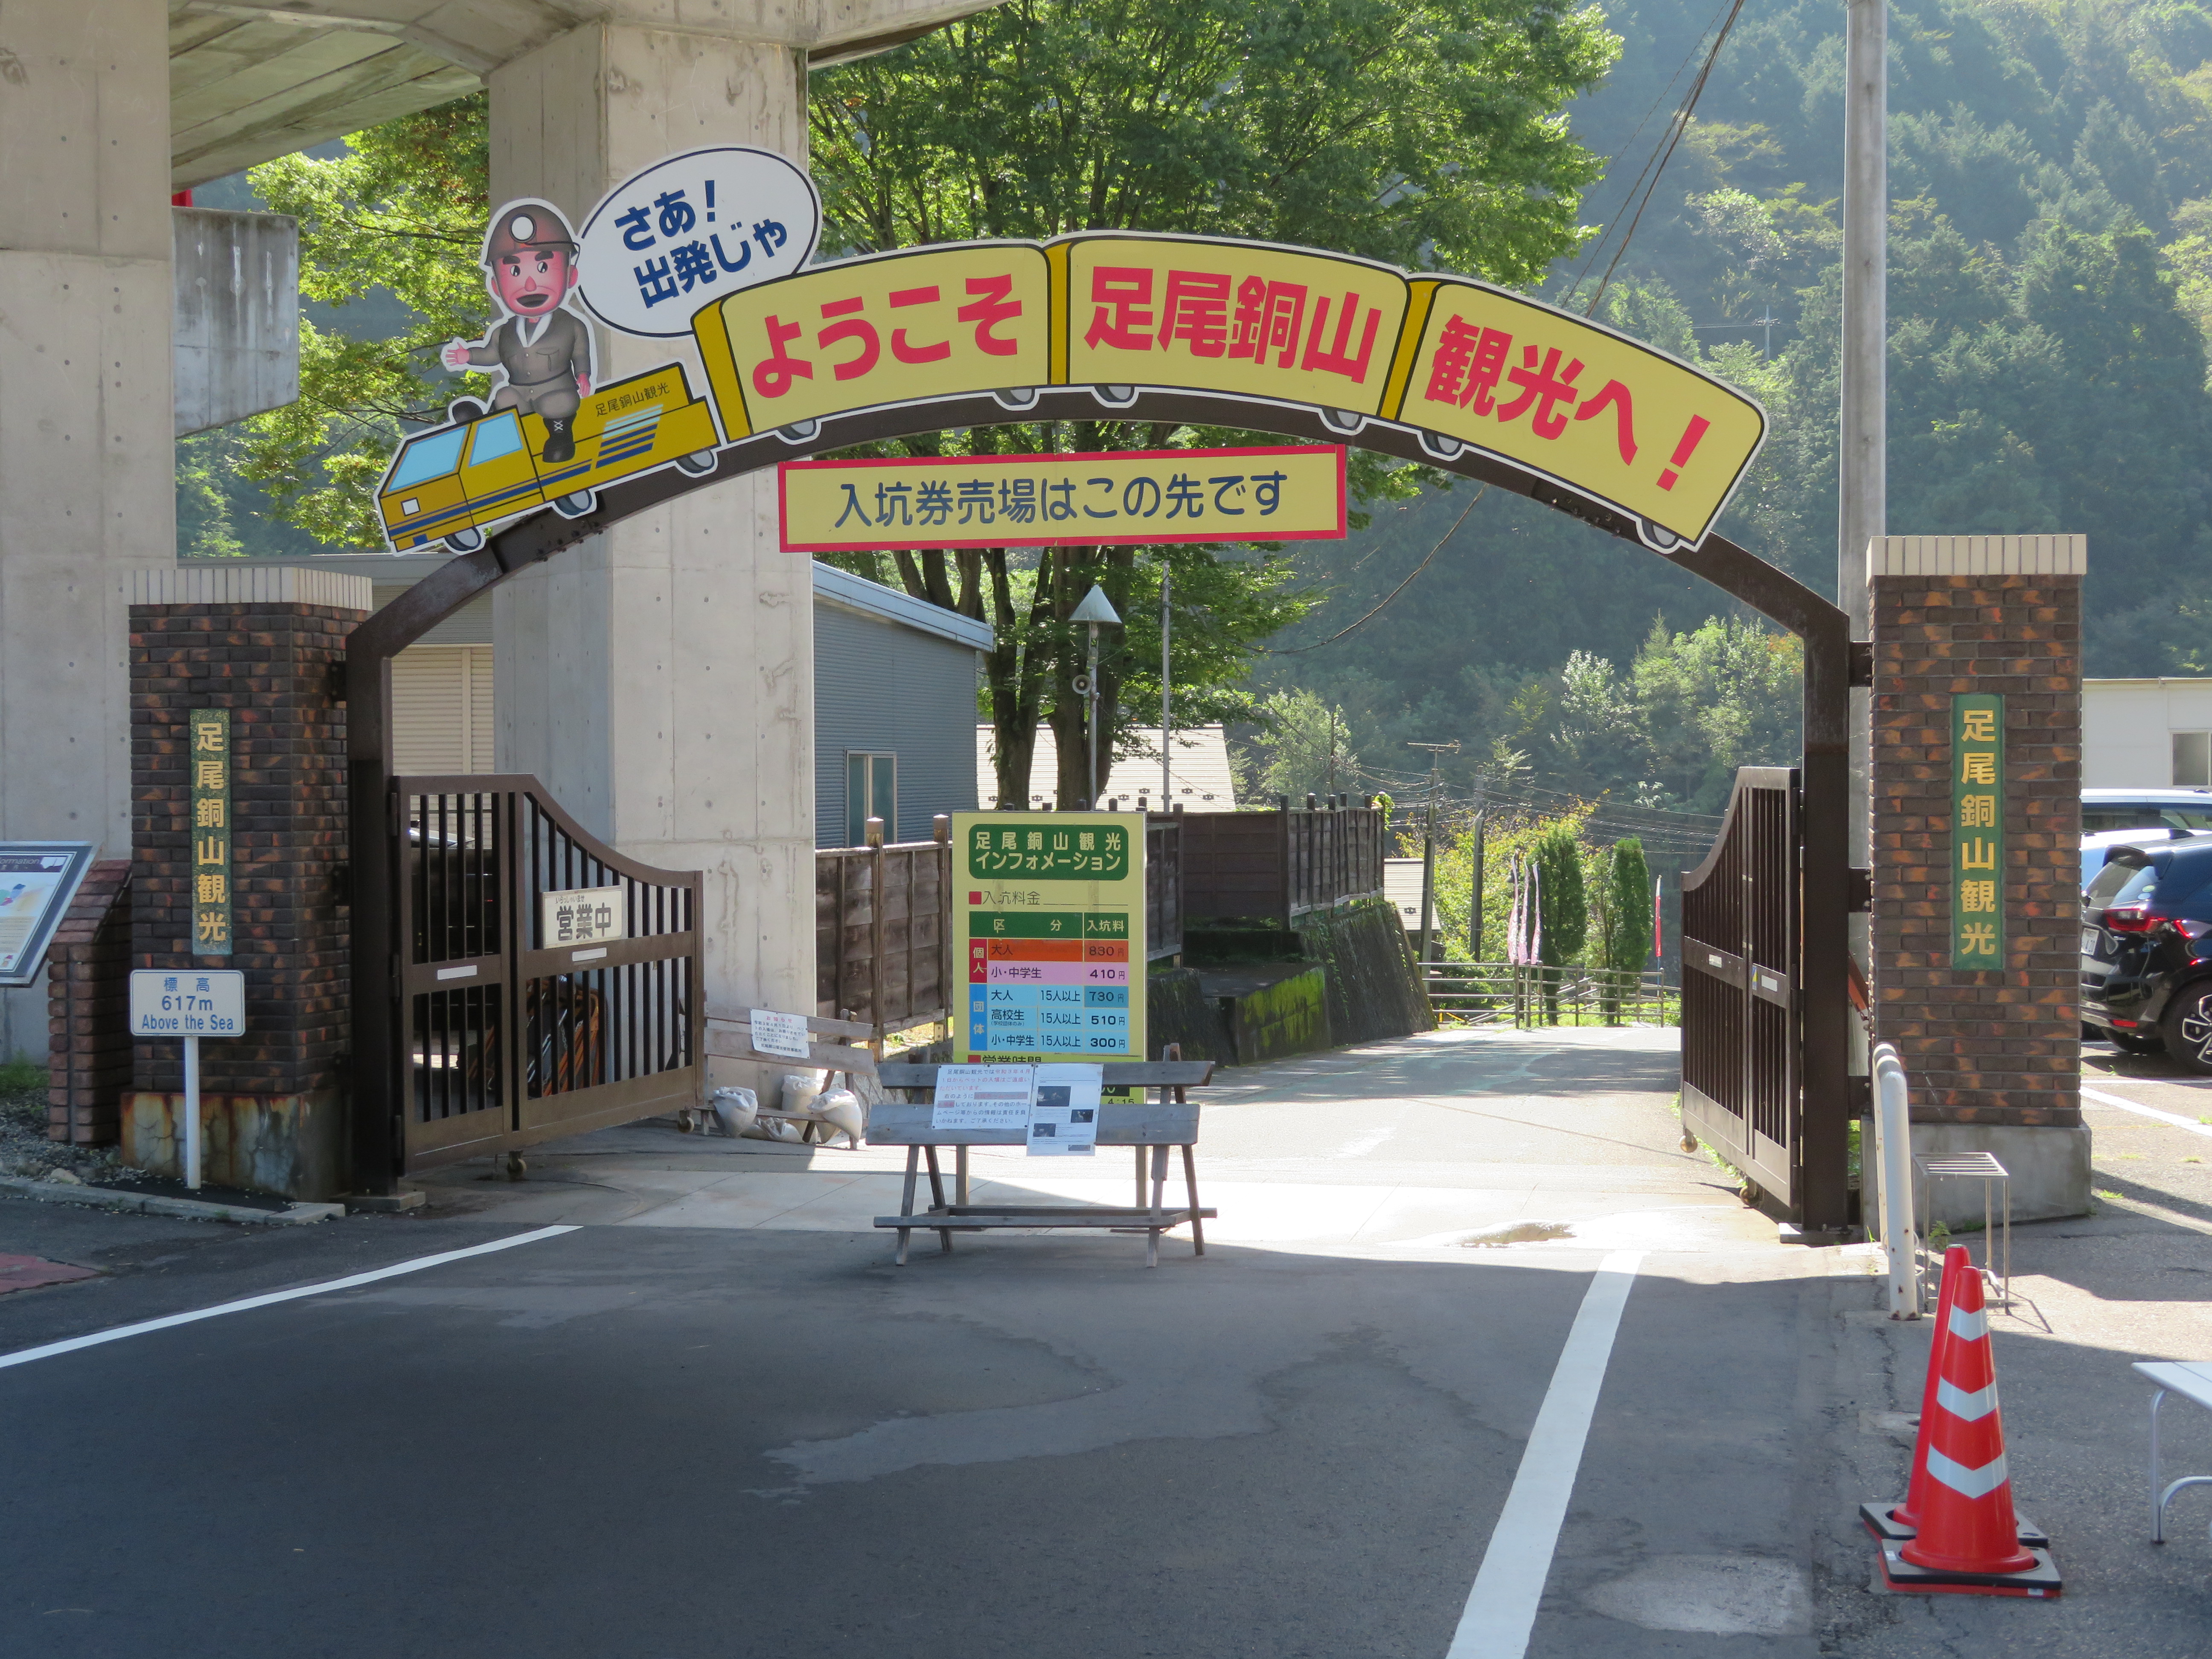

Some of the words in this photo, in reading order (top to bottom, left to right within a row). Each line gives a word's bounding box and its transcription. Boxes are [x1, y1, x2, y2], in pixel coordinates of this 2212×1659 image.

[614, 180, 716, 252] さあ！
[633, 218, 788, 308] 出発じゃ
[752, 274, 1023, 398] ようこそ
[1084, 265, 1382, 384] 足尾銅山
[596, 383, 670, 417] 足尾銅山観光
[833, 469, 1289, 528] 入坑券売場はこの先です
[196, 722, 226, 941] 足尾銅山観光
[1961, 710, 1995, 955] 足尾銅山観光
[976, 832, 1121, 851] 足尾銅山観光
[975, 852, 1121, 870] インフォメーション
[555, 895, 585, 904] いらっしゃいませ
[982, 891, 1041, 905] 入坑料金
[557, 902, 611, 941] 営業中
[1087, 920, 1124, 932] 入坑料
[991, 944, 1013, 955] 大人
[973, 947, 984, 973] 個人
[991, 967, 1042, 978] 小・中学生
[162, 995, 213, 1010] 617m
[991, 990, 1013, 1001] 大人
[1041, 990, 1080, 1001] 15人以上
[142, 1014, 178, 1029] Above
[185, 1014, 204, 1029] the
[210, 1014, 233, 1030] Sea
[973, 1001, 984, 1034] 団体
[991, 1009, 1024, 1020] 高校生
[1041, 1013, 1081, 1025] 15人以上
[991, 1034, 1034, 1046] 小・中学生
[1041, 1035, 1081, 1047] 15人以上
